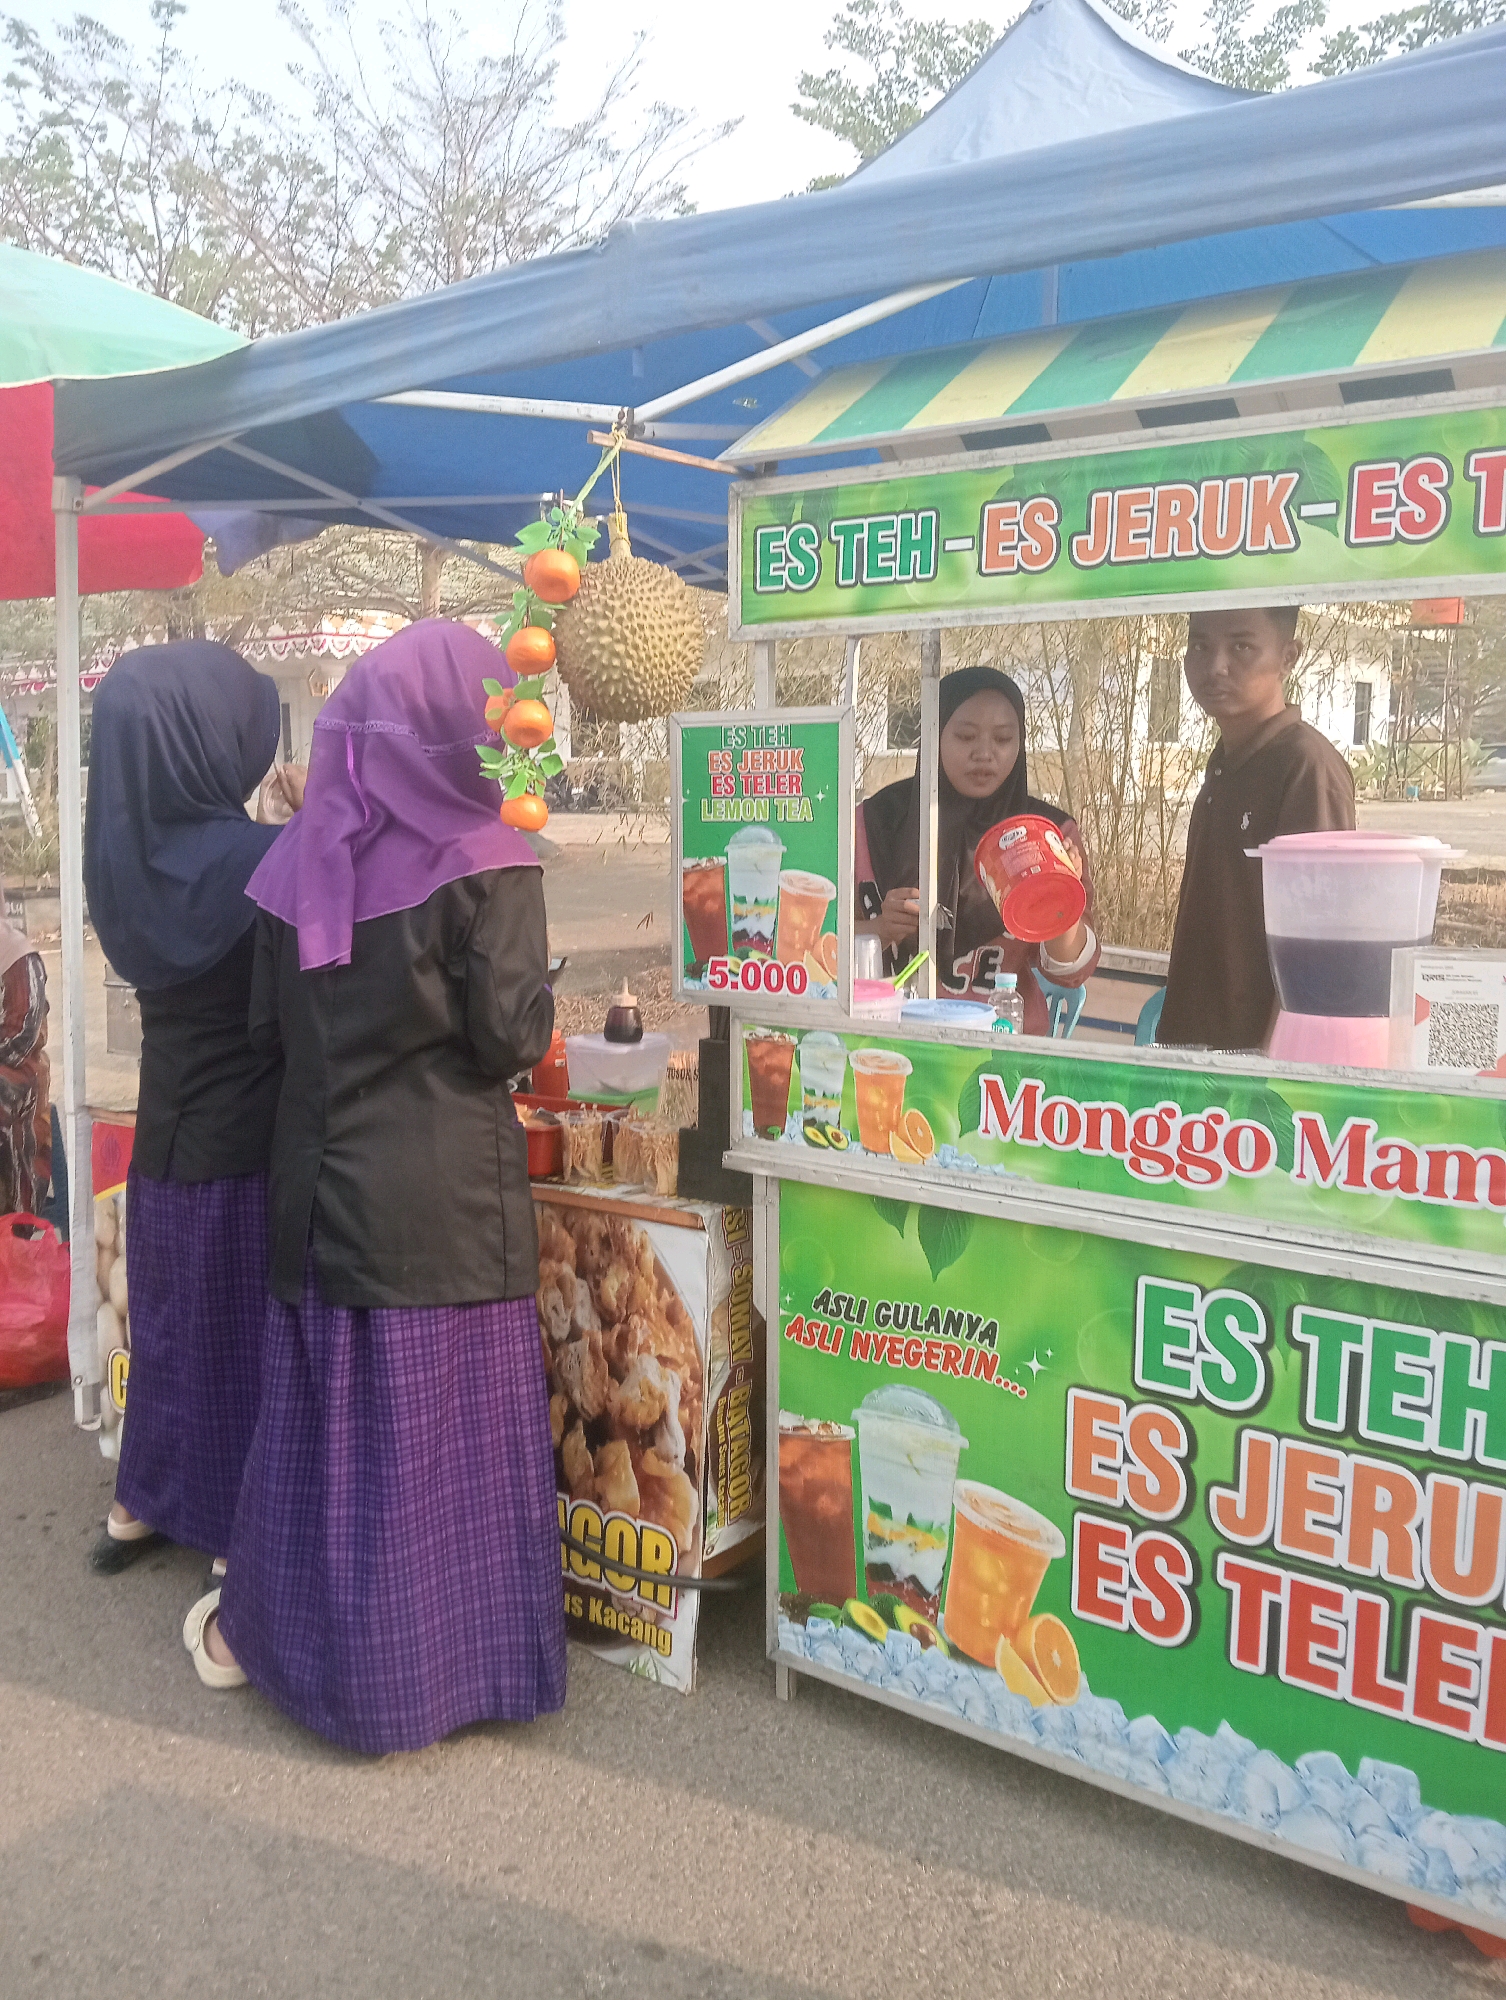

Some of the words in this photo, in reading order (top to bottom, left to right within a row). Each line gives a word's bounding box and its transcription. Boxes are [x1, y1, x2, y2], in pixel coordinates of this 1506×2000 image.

[757, 525, 819, 592] ES
[832, 512, 936, 585] TEH
[980, 497, 1059, 572] ES
[1073, 474, 1300, 566] JERUK
[1350, 457, 1450, 546] ES
[708, 751, 732, 773] ES
[738, 749, 804, 772] JERUK
[722, 726, 747, 748] ES
[752, 725, 791, 747] TEH
[701, 798, 769, 822] LEMON
[774, 798, 813, 822] TEA
[711, 775, 735, 797] ES
[741, 774, 803, 796] TELER
[707, 957, 808, 995] 5.000
[979, 1074, 1276, 1190] Monggo
[1294, 1110, 1506, 1207] Mam
[730, 1262, 754, 1363] SOMAY
[784, 1314, 844, 1355] ASLI
[813, 1287, 868, 1326] ASLI
[874, 1300, 999, 1348] GULANYA
[1135, 1275, 1267, 1411] ES
[1293, 1305, 1506, 1467] TEH
[729, 1382, 752, 1522] BATAGOR
[1066, 1388, 1188, 1521] ES
[1072, 1511, 1193, 1647] ES
[588, 1597, 672, 1657] Kacang
